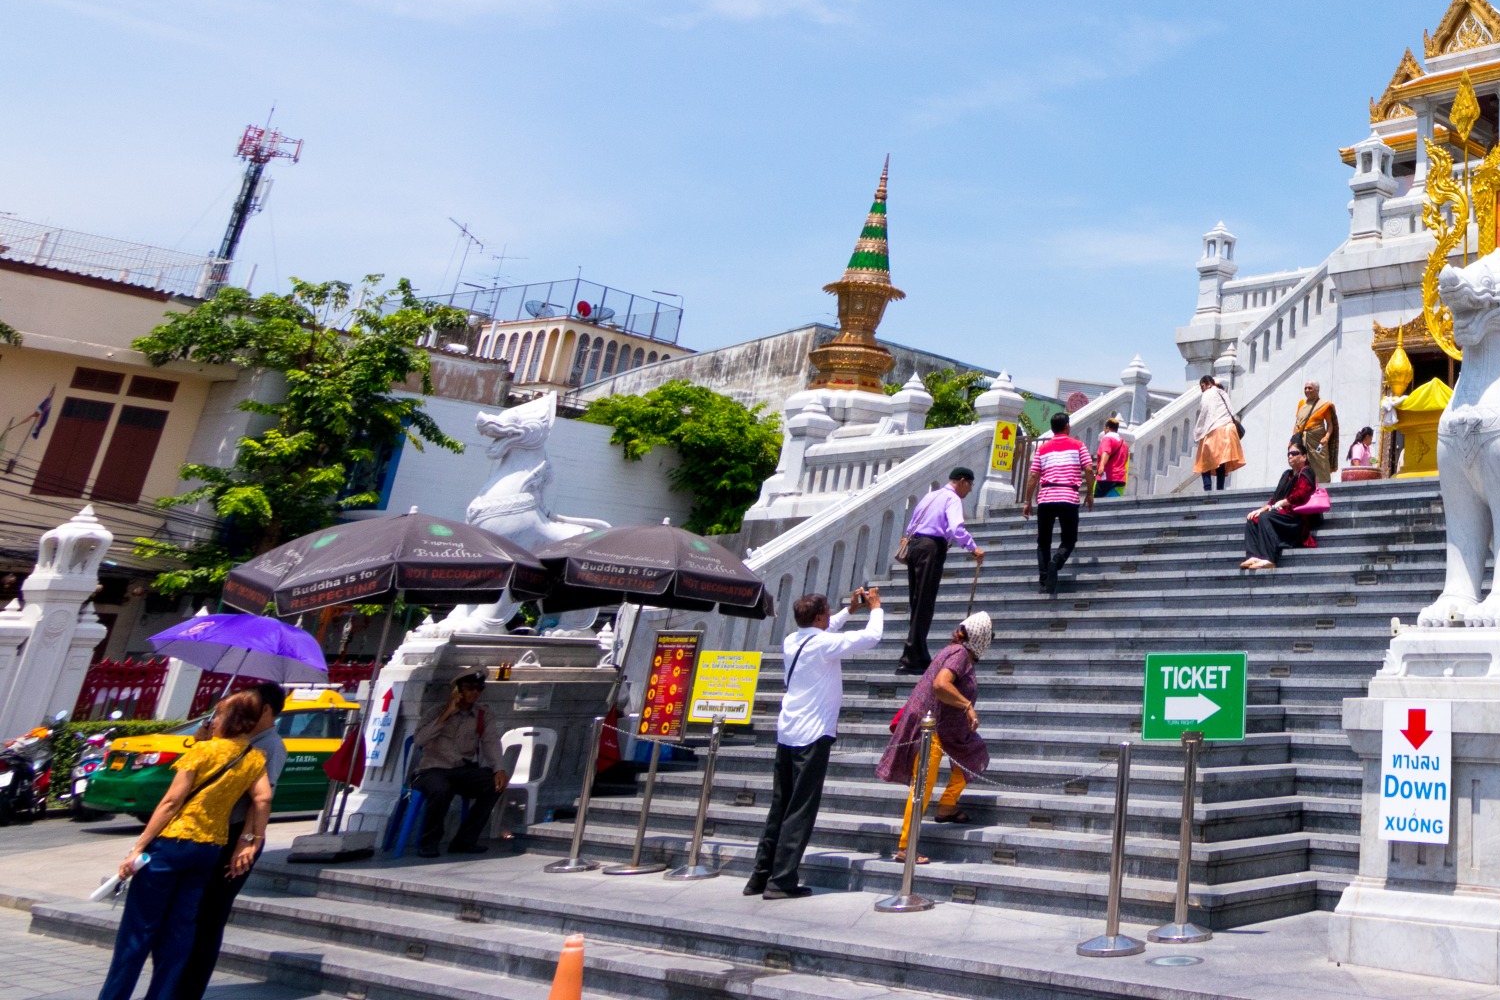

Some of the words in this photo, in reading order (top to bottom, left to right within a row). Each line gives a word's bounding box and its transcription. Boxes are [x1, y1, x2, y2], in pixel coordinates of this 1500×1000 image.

[413, 548, 484, 559] Buddha
[404, 568, 428, 580] NOT
[430, 568, 504, 581] DECORATION
[580, 561, 627, 575] Buddha
[628, 565, 640, 576] is
[642, 566, 660, 578] for
[685, 560, 738, 576] Buddha
[292, 577, 342, 597] Buddha
[345, 571, 357, 584] is
[360, 567, 379, 582] for
[576, 572, 656, 589] RESPECTING
[680, 577, 698, 589] NOT
[701, 580, 755, 597] DECORATION
[290, 580, 378, 608] RESPECTING
[1160, 665, 1231, 690] TICKET
[372, 729, 386, 745] Up
[1392, 754, 1440, 771] ทางลง
[1384, 774, 1447, 801] Down
